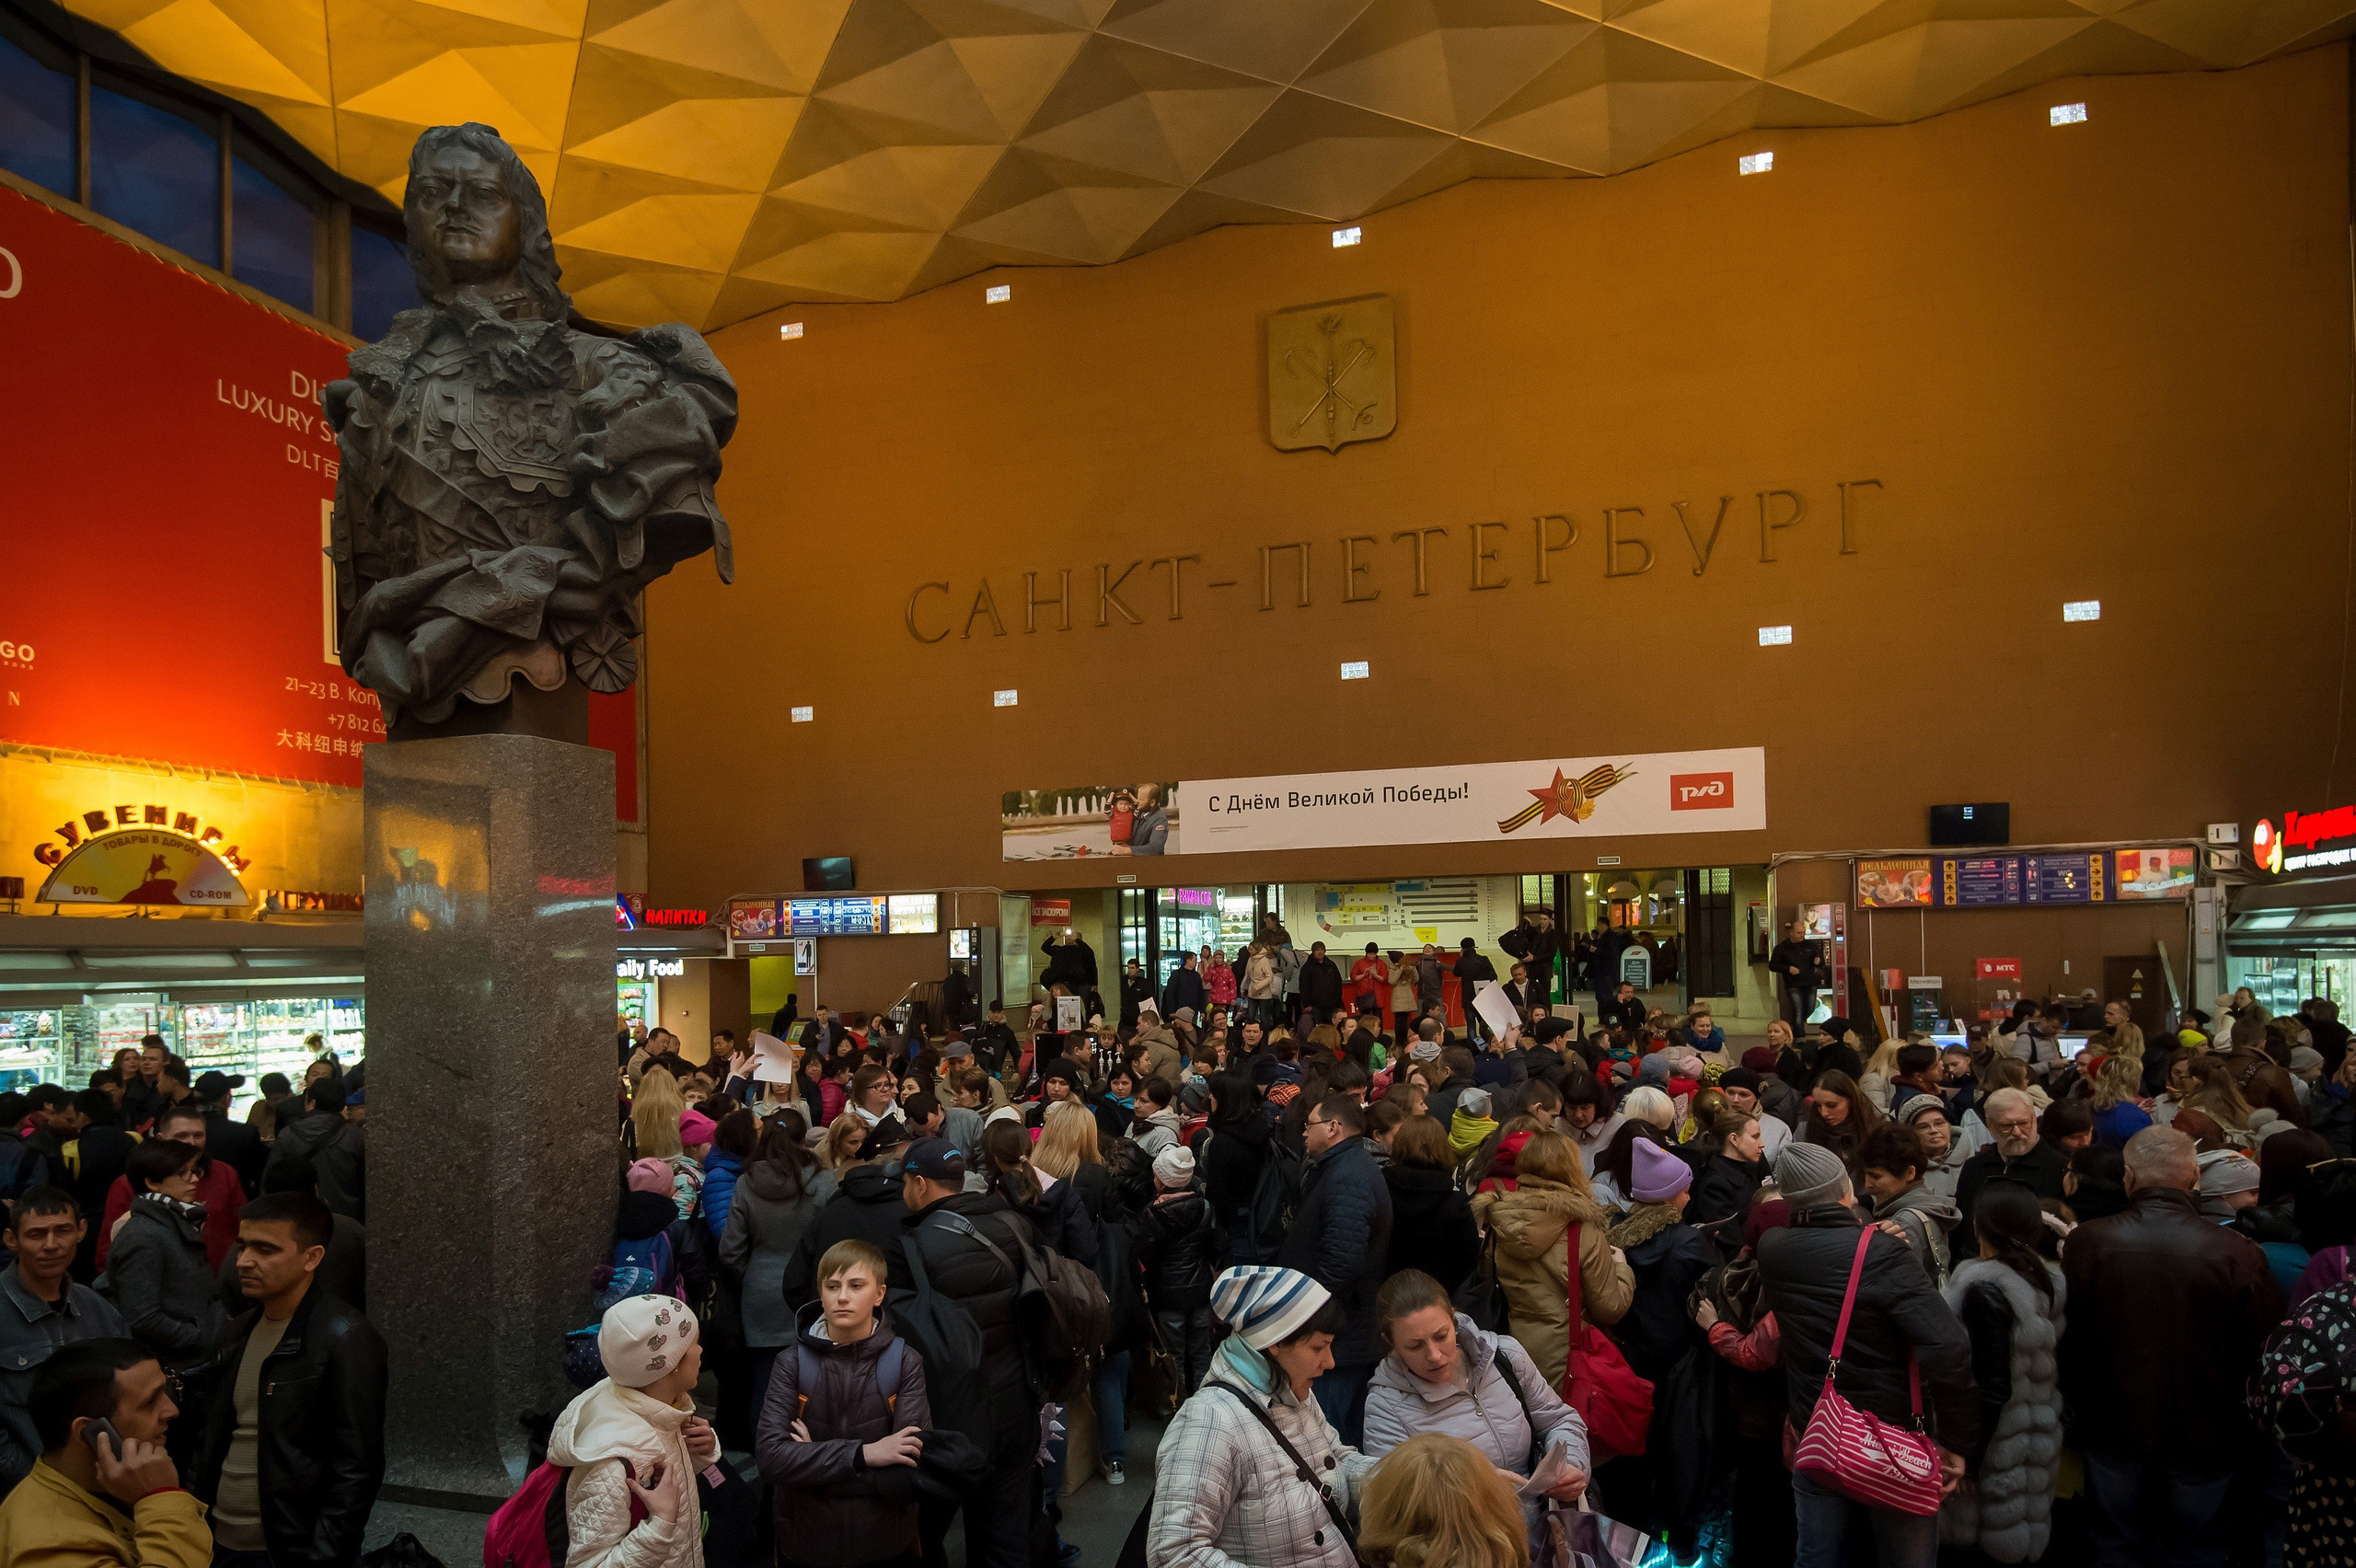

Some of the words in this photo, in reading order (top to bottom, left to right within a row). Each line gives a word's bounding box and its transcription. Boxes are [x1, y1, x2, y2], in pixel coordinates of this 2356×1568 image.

[292, 370, 327, 406] DL
[217, 378, 314, 434] LUXURY
[905, 477, 1885, 644] САНКТ-ПЕТЕРБУРГ
[328, 713, 345, 730] +7
[348, 713, 369, 732] 812
[1209, 796, 1220, 812] С
[1227, 793, 1279, 814] Днём
[1288, 788, 1374, 808] Великой
[1383, 782, 1469, 803] Победы!
[102, 835, 149, 851] ТОВАРЫ
[153, 835, 159, 844] В
[161, 837, 203, 858] ДОРОГУ
[1861, 860, 1930, 871] ПЕЛЬМЕННАЯ
[73, 885, 98, 895] DVD
[190, 890, 232, 900] CD-ROM
[1168, 888, 1200, 905] СУЕНИРЫ
[645, 908, 707, 925] НАПИТКИ
[616, 959, 645, 980] aily
[648, 959, 684, 976] Food
[1899, 1446, 1933, 1470] Beach
